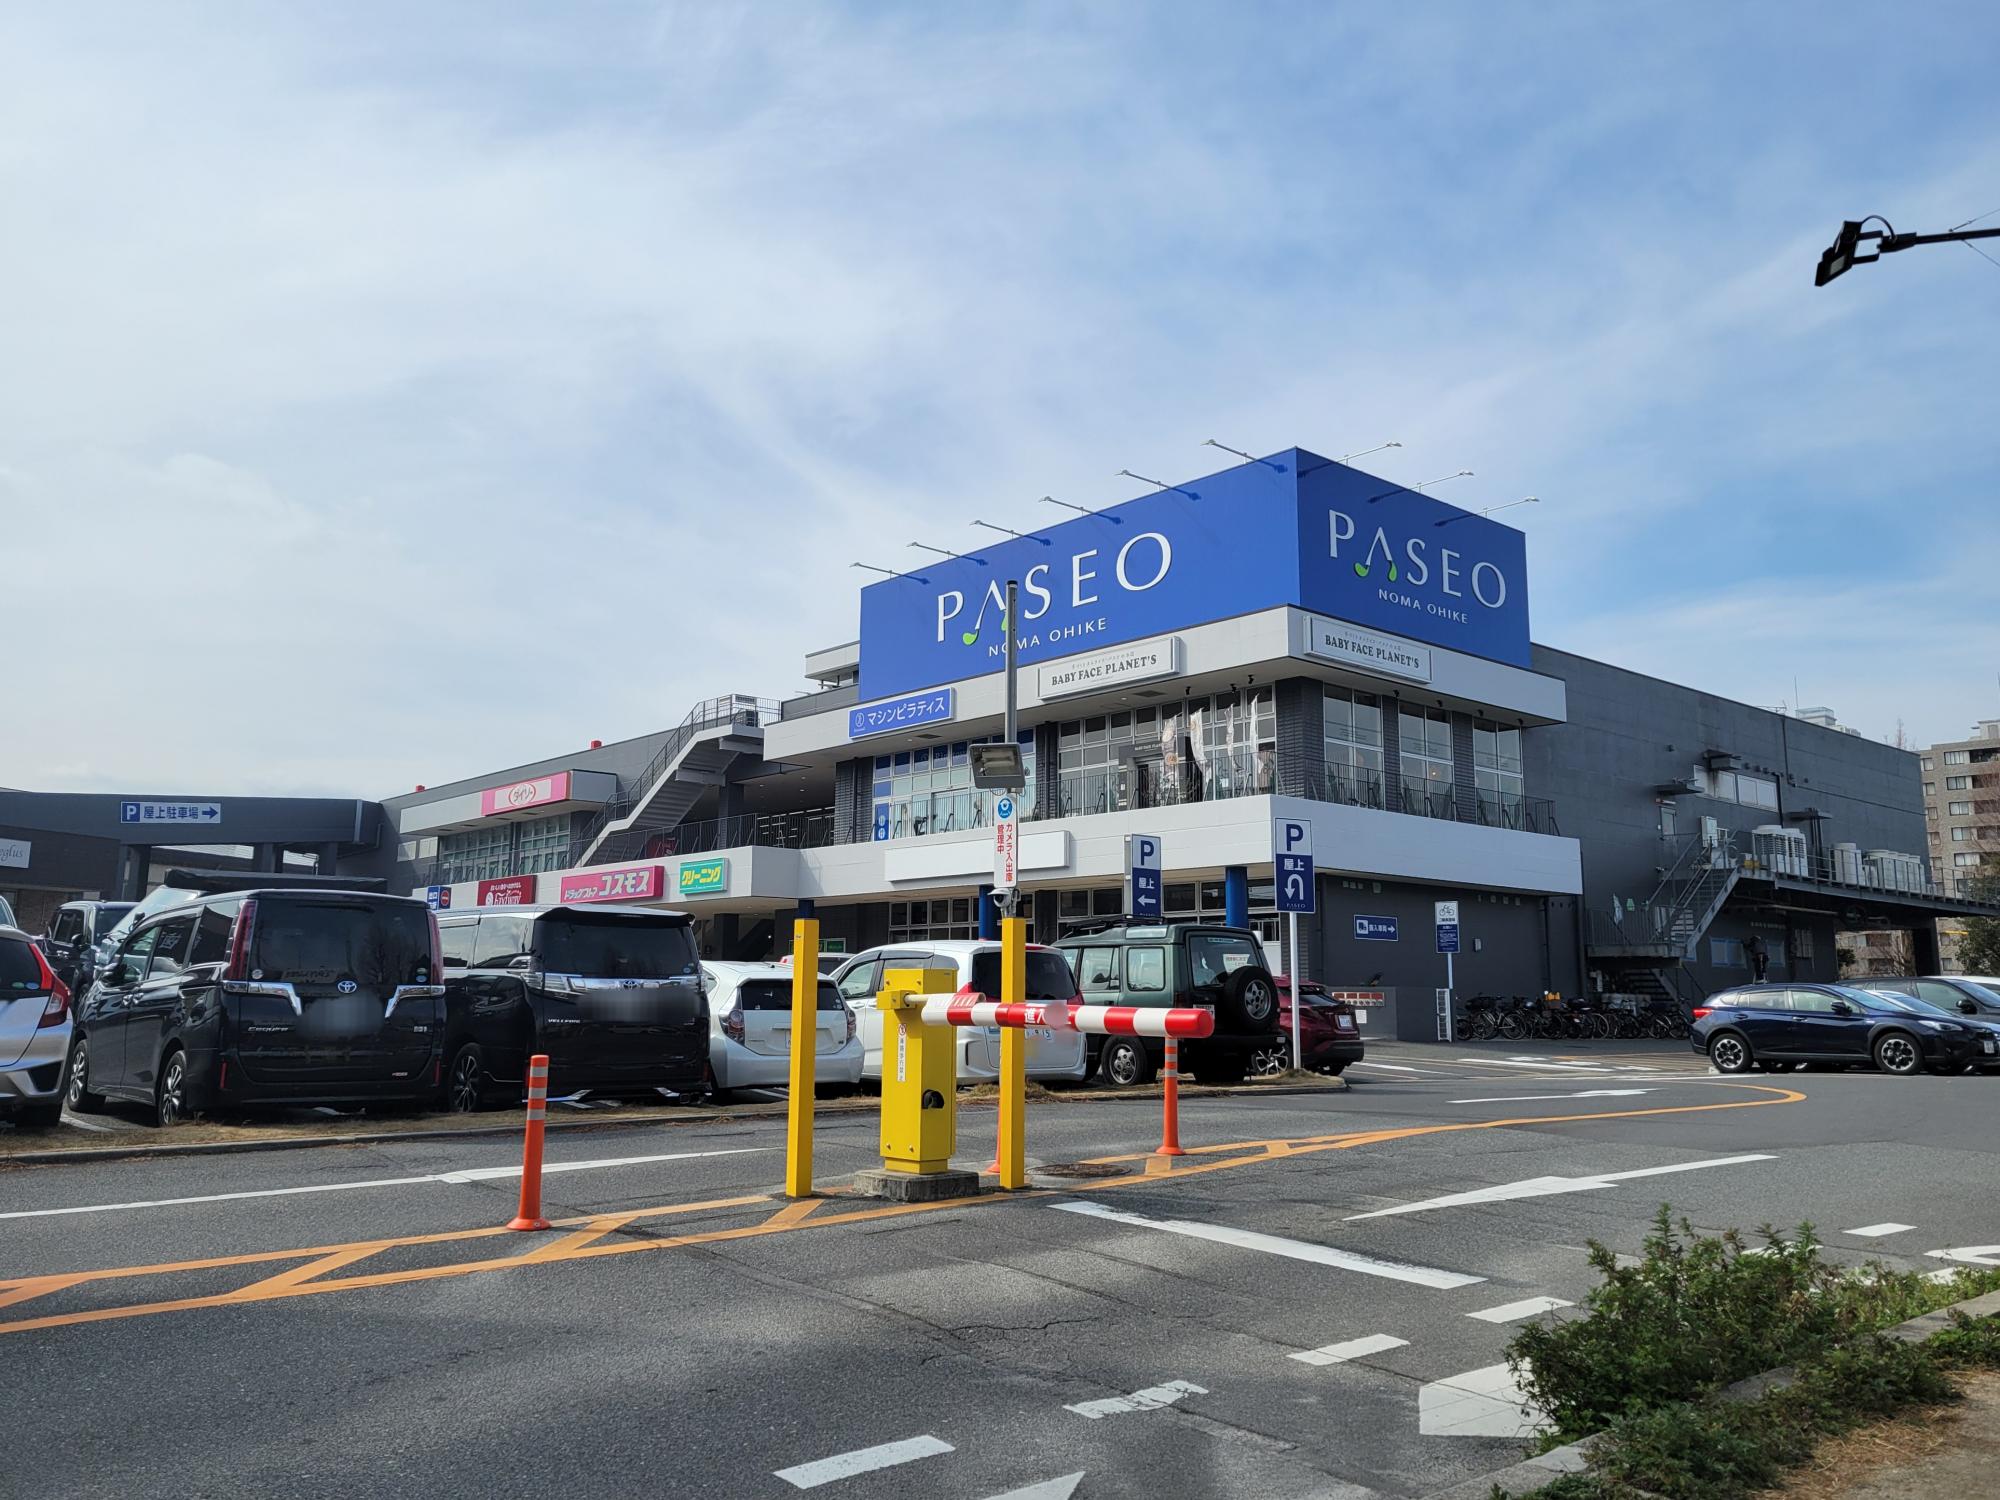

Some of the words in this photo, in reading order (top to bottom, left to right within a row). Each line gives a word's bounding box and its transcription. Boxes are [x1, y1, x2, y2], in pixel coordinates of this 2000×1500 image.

[1329, 509, 1507, 609] PASEO
[937, 532, 1172, 644] PASEO
[1378, 588, 1421, 611] NOMA
[1427, 603, 1468, 624] OHIKE
[1049, 617, 1107, 642] OHIKE
[1325, 634, 1349, 650] BABY
[1351, 641, 1374, 657] FACE
[1376, 648, 1420, 669] PLANET'S
[1051, 672, 1076, 686] BABY
[1078, 666, 1102, 680] FACE
[1105, 654, 1157, 675] PLANET'S
[867, 697, 945, 726] マシンピラティス
[126, 805, 137, 820] P
[143, 805, 199, 820] 屋上駐車場
[1286, 823, 1304, 852] P
[1140, 839, 1155, 866] P
[1284, 858, 1305, 871] 屋上
[598, 870, 650, 896] コスモス
[681, 865, 722, 886] クリーニング
[1138, 876, 1155, 889] 屋上
